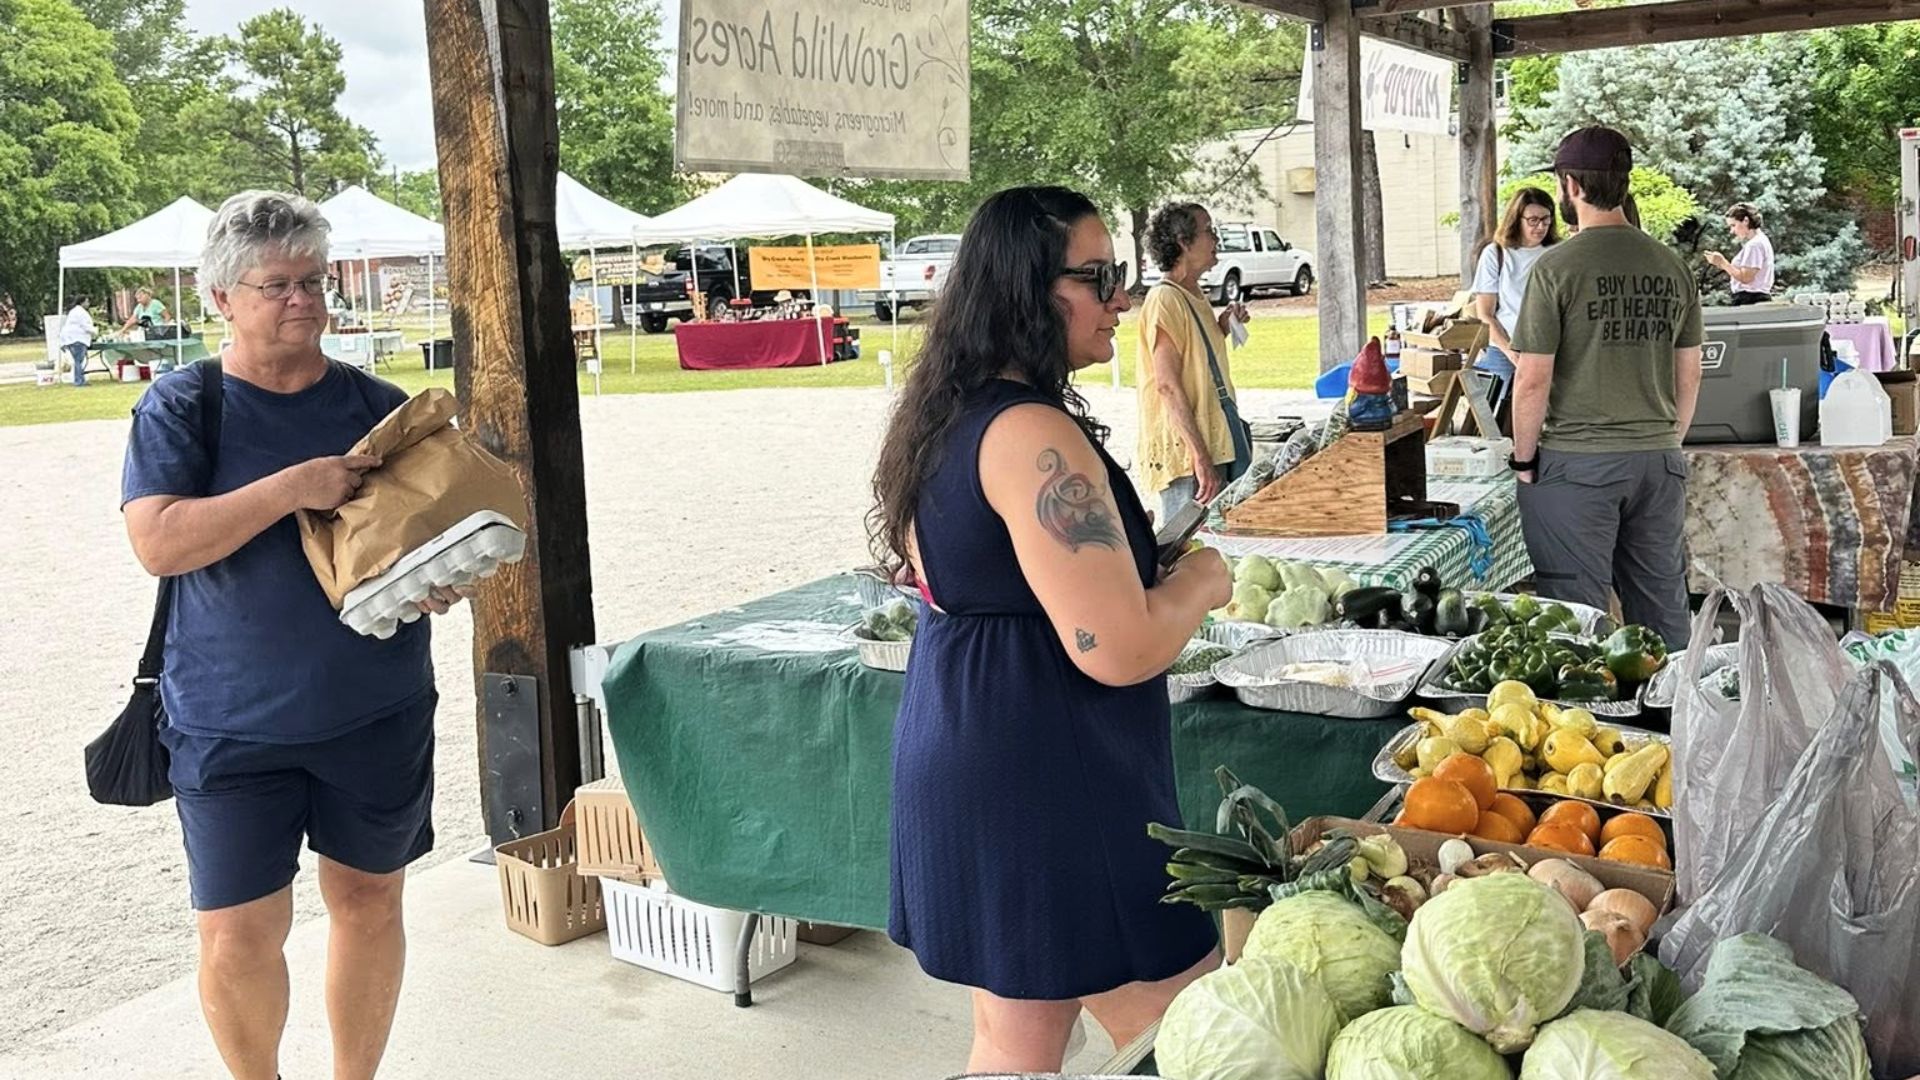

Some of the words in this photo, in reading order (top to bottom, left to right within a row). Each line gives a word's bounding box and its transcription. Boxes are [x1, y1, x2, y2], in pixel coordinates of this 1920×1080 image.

[1596, 275, 1626, 297] BUY
[1632, 275, 1681, 298] LOCAL
[1587, 298, 1617, 320] EAT
[1602, 321, 1621, 340] BE
[1625, 321, 1676, 342] HAPPY
